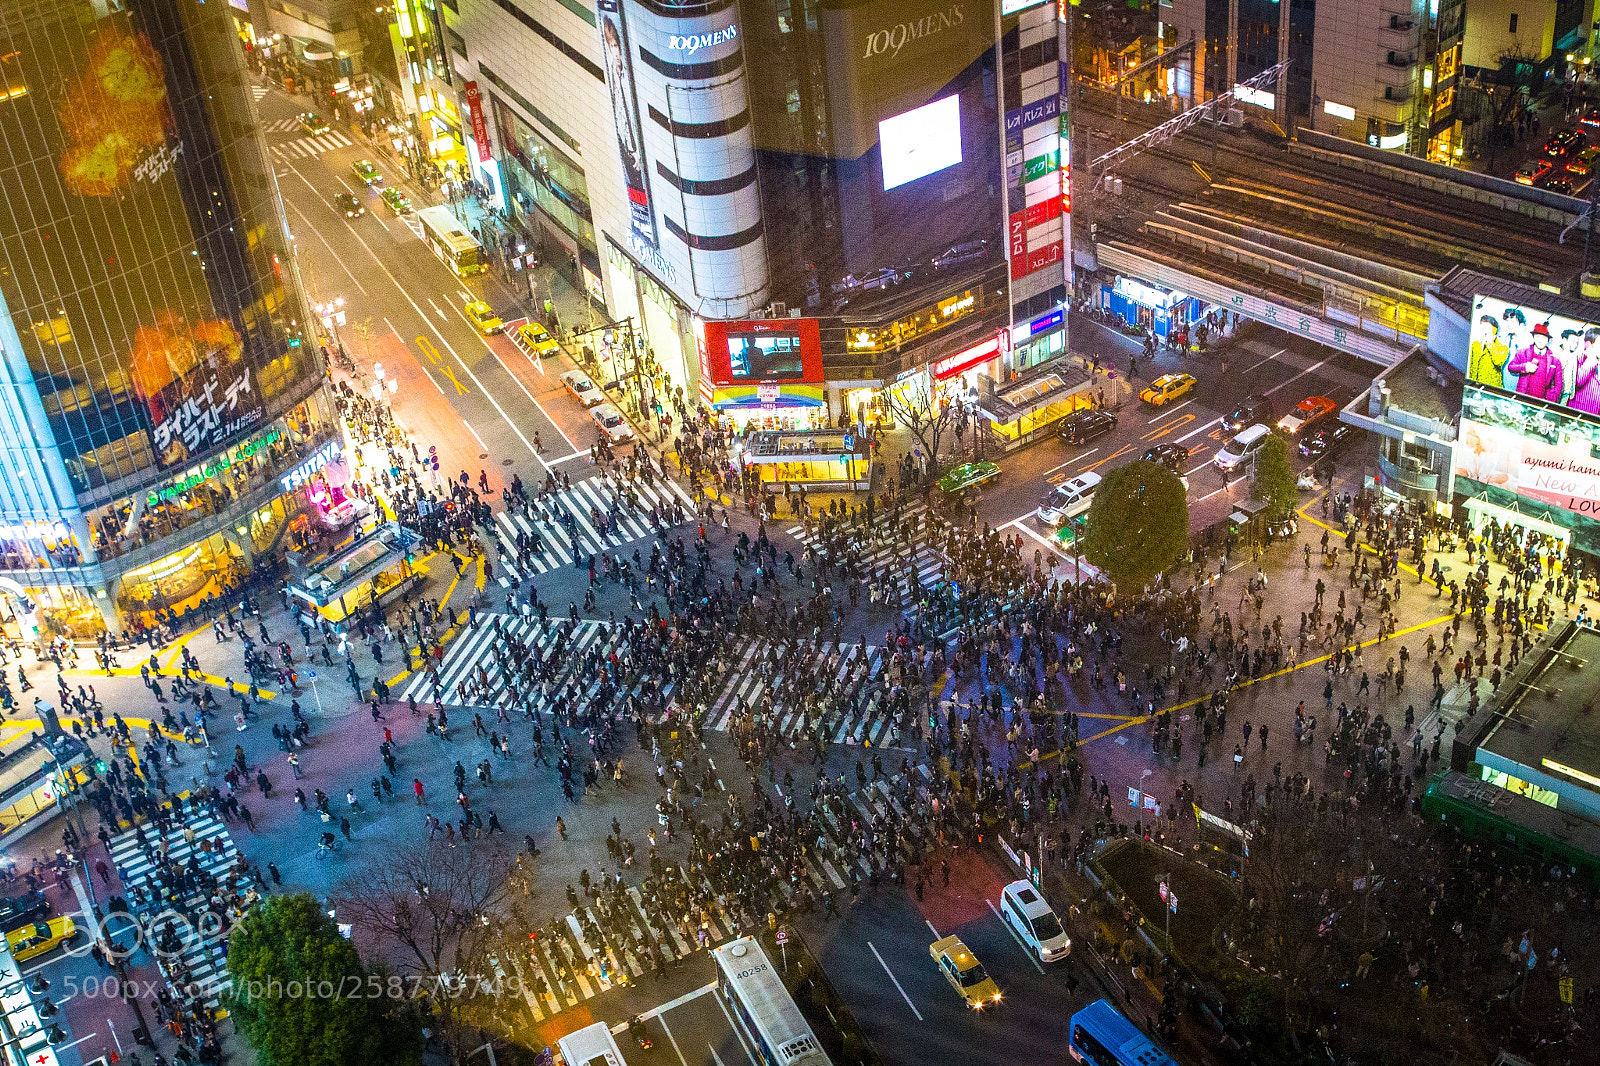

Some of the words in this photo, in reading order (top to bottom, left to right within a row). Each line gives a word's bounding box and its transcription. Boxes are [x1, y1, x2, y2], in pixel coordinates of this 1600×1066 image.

[1012, 220, 1024, 256] アコム
[1032, 256, 1045, 270] 入口
[1231, 295, 1244, 307] JR
[1265, 303, 1348, 346] 渋谷駅
[212, 418, 241, 444] 2.14
[280, 441, 341, 492] TSUTAYA
[1524, 456, 1569, 471] ayumi
[148, 458, 231, 507] STARBUCKS
[1535, 474, 1577, 493] New
[736, 963, 768, 980] 40258
